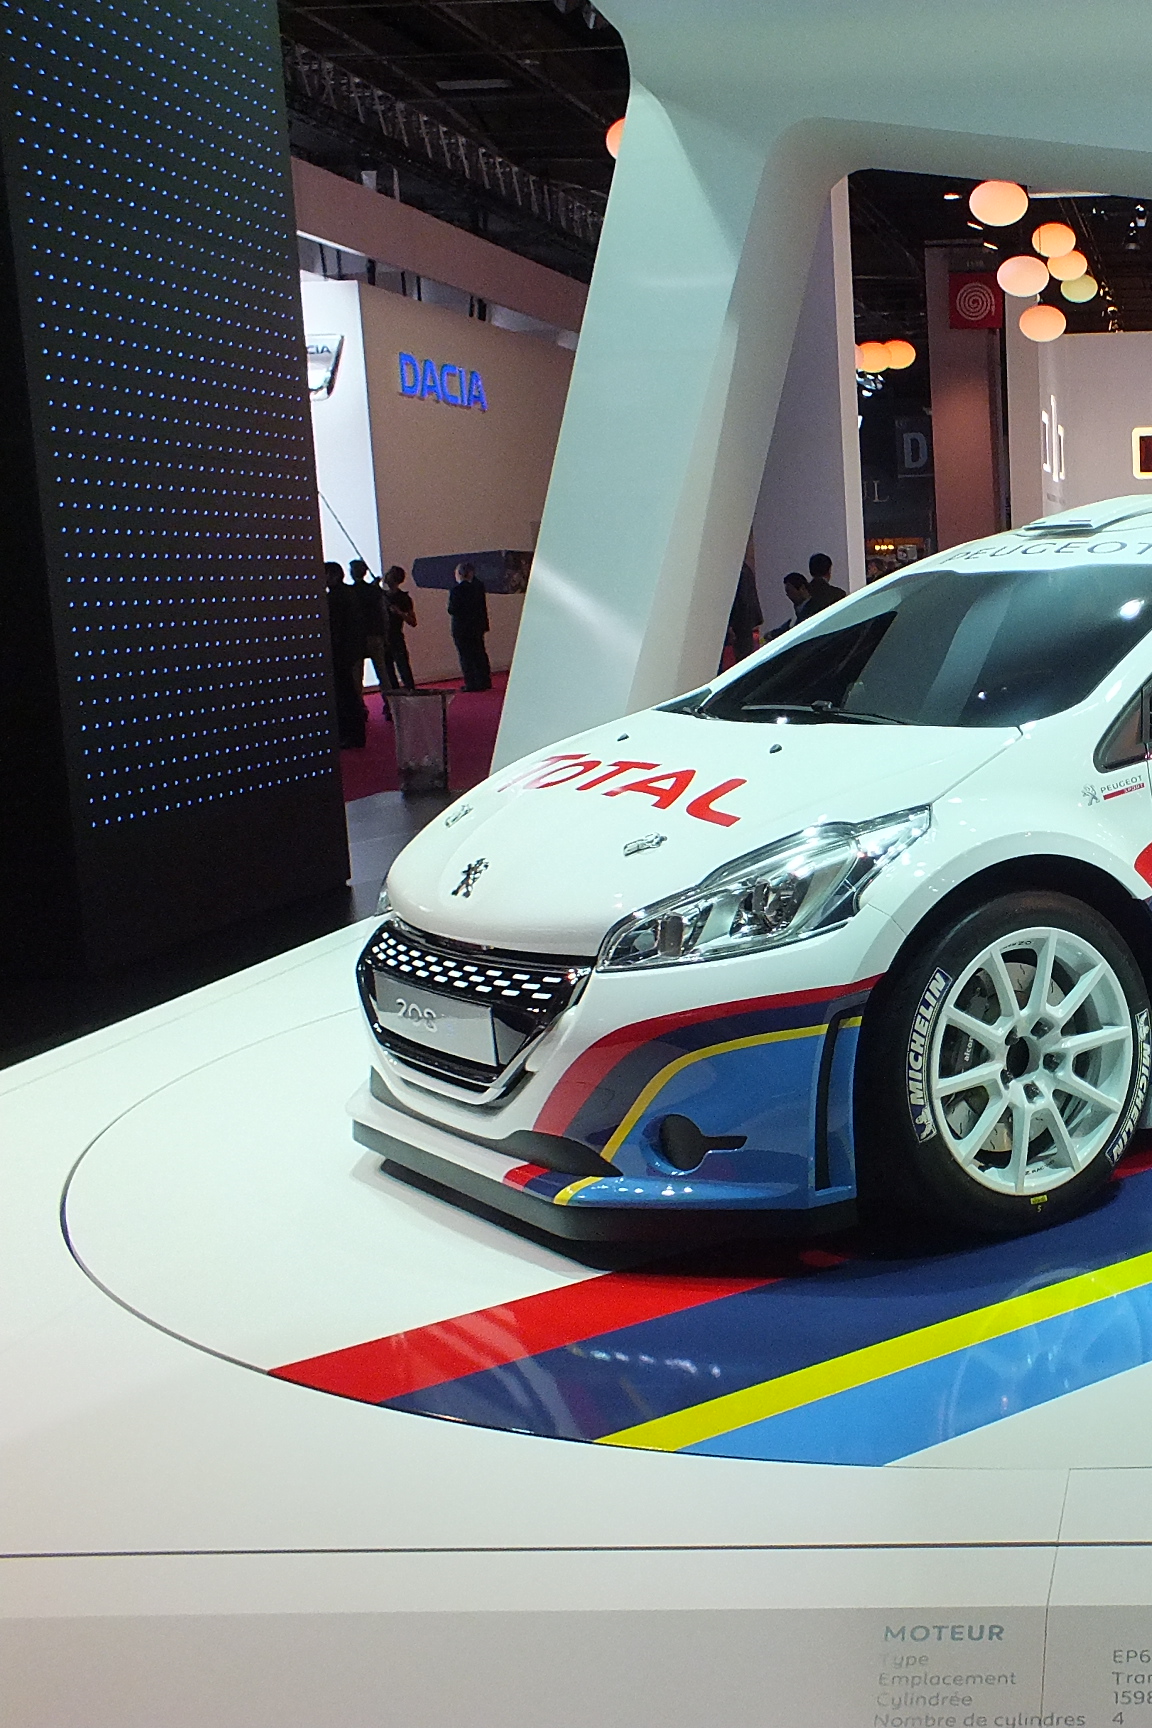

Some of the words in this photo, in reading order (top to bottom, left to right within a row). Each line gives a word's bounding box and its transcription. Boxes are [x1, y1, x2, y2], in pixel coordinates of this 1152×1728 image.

[398, 351, 488, 411] DACIA
[497, 752, 748, 828] TOTAL
[1100, 774, 1143, 794] PEUGEOT
[908, 972, 946, 1106] MICHELIN
[1112, 1042, 1151, 1161] MICHELIN
[883, 1624, 1005, 1642] MOTEUR
[1112, 1648, 1152, 1664] EP6
[878, 1672, 1017, 1689] Emplacement
[876, 1691, 974, 1711] Cylindrée
[873, 1713, 957, 1728] Nombre
[962, 1712, 988, 1727] de
[993, 1711, 1086, 1728] cylindres
[1111, 1711, 1125, 1726] 4
